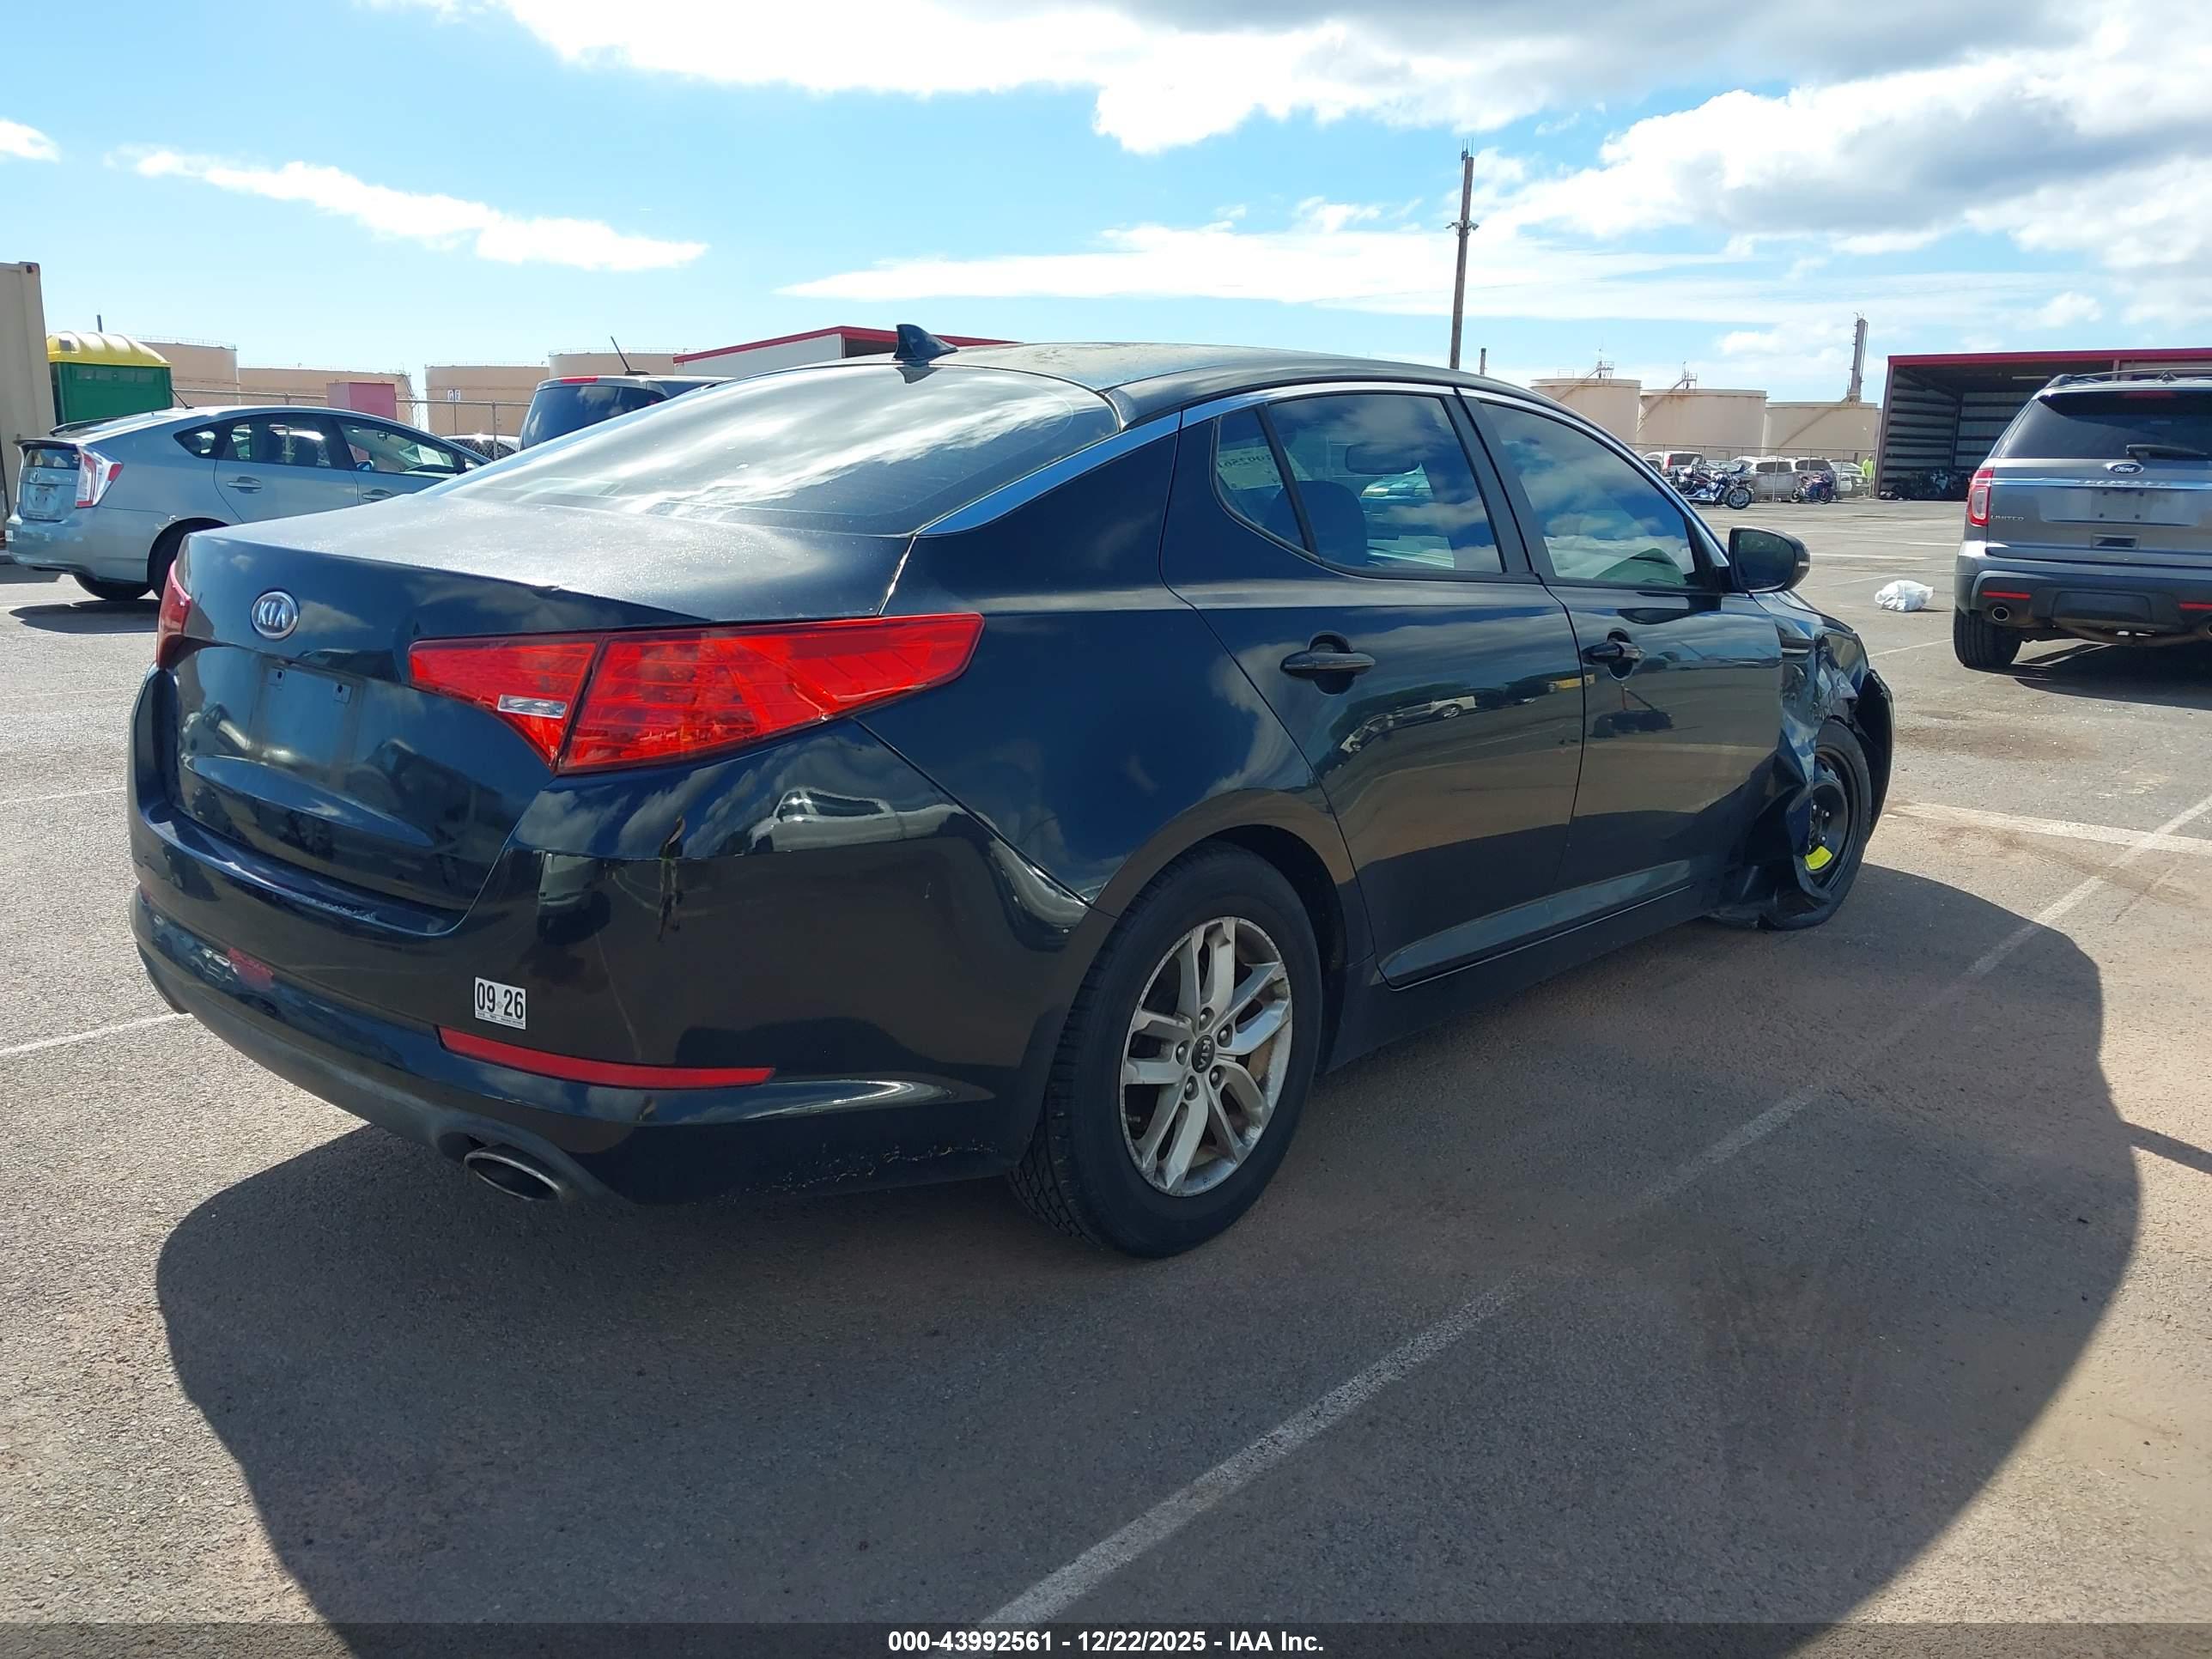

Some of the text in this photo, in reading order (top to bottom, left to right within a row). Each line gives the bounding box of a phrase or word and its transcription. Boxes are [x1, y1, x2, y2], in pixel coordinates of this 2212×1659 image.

[258, 600, 287, 629] KIA
[477, 981, 496, 1013] 09
[503, 988, 524, 1020] 26
[1197, 1039, 1211, 1069] KIA
